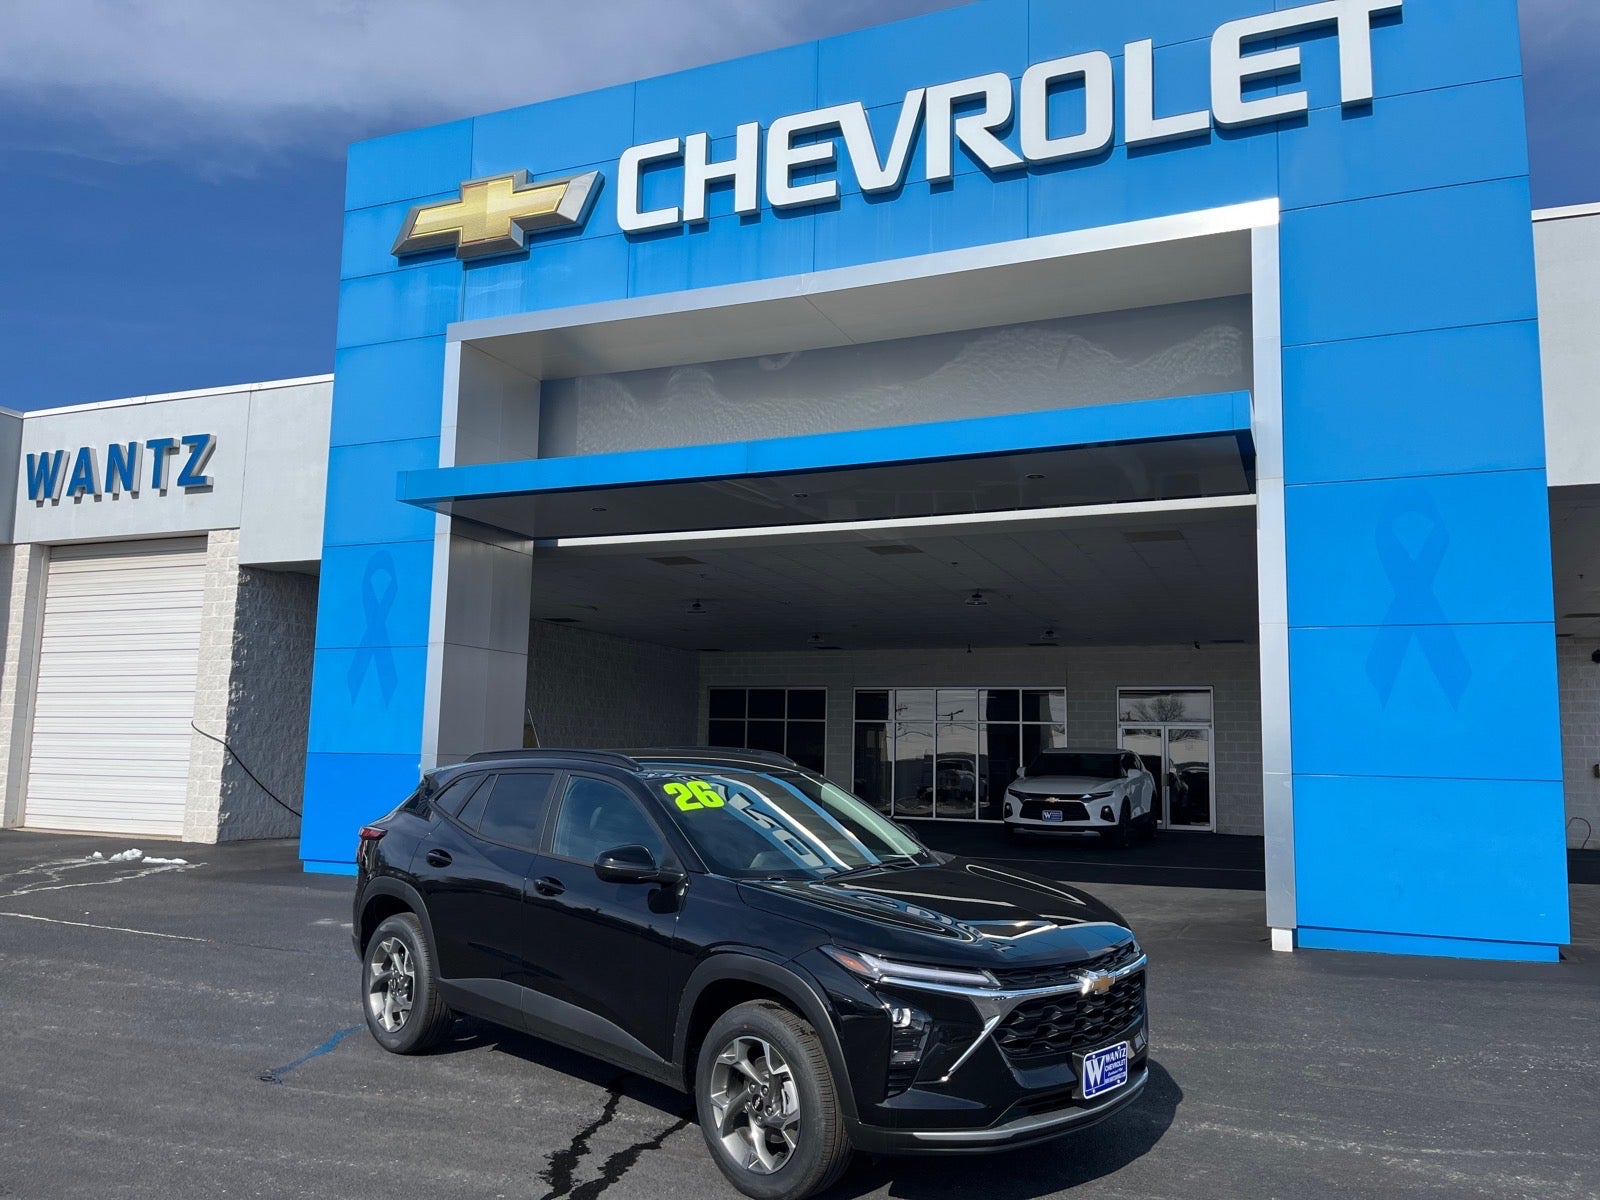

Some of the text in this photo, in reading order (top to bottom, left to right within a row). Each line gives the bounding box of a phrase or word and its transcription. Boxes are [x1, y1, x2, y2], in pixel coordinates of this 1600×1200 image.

[617, 0, 1403, 231] CHEVROLET
[26, 434, 216, 502] WANTZ
[663, 781, 725, 812] 26
[1104, 1058, 1126, 1072] CHEVROLET
[1105, 1048, 1126, 1063] WANTZ
[1085, 1056, 1105, 1088] W
